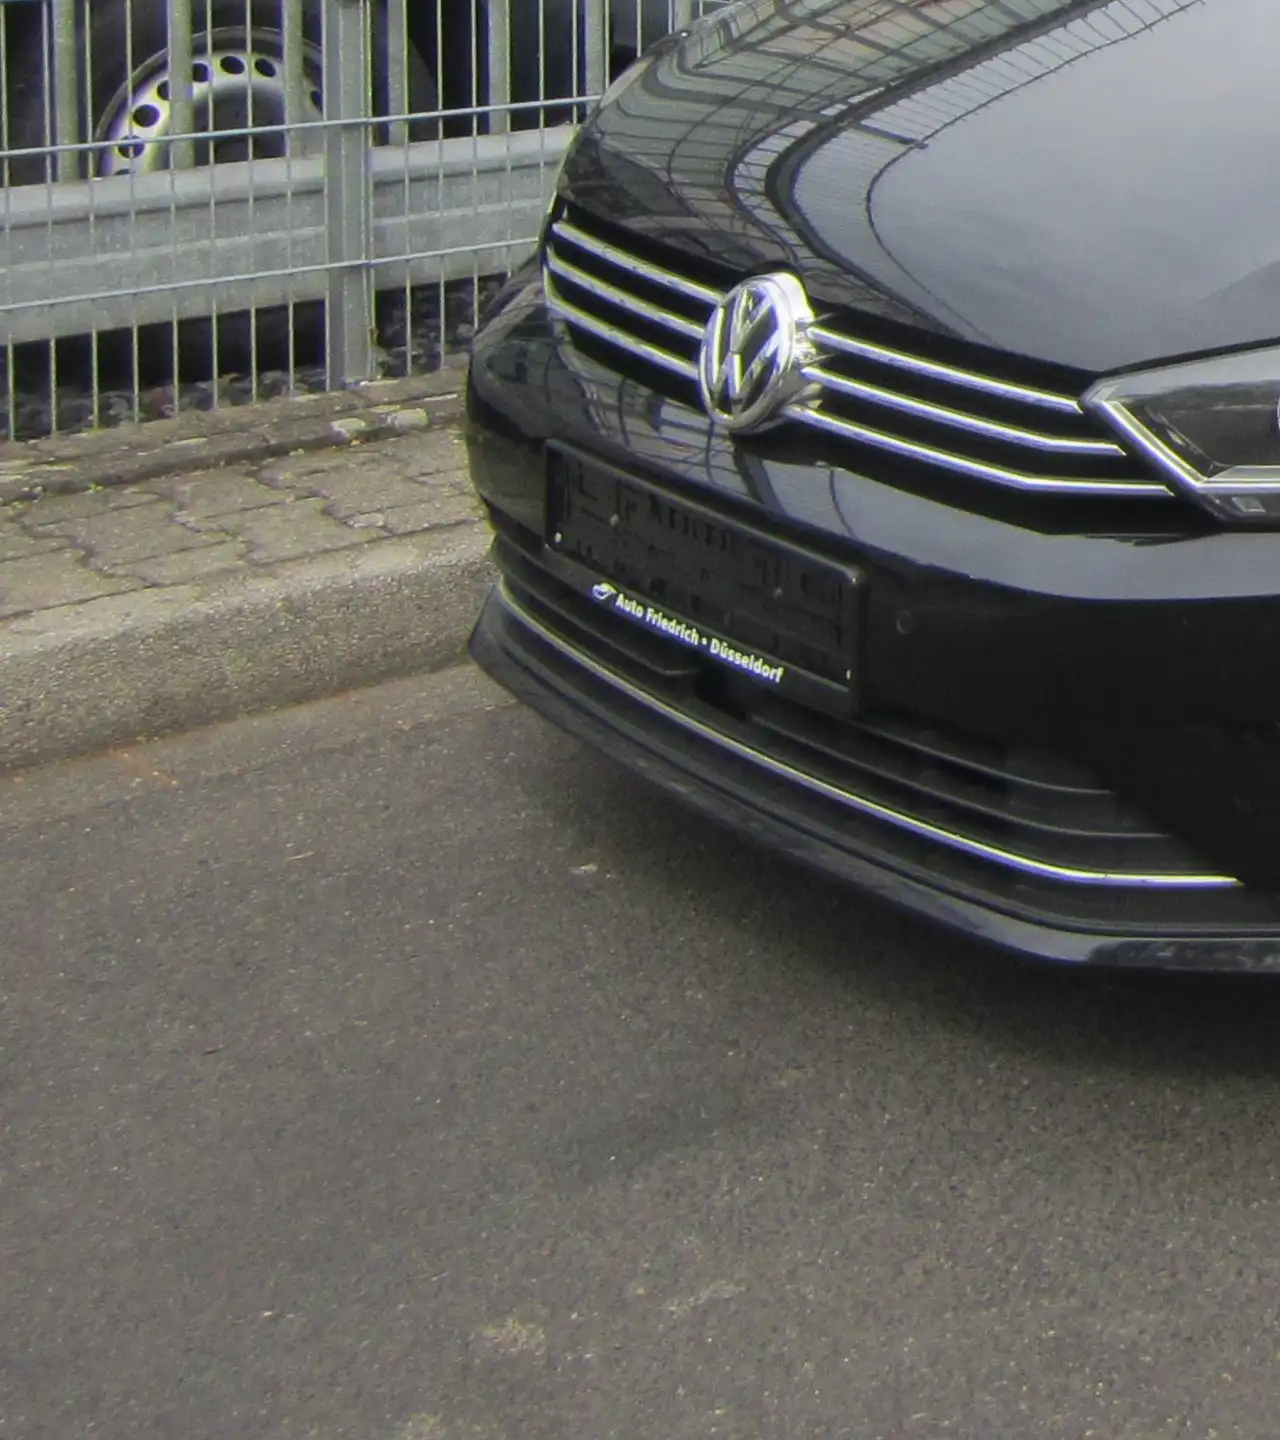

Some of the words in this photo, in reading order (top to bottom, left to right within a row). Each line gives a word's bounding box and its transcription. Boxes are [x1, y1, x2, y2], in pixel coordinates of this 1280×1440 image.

[615, 593, 643, 617] Auto
[645, 608, 699, 646] Friedrich
[709, 637, 784, 683] Düsseldorf
